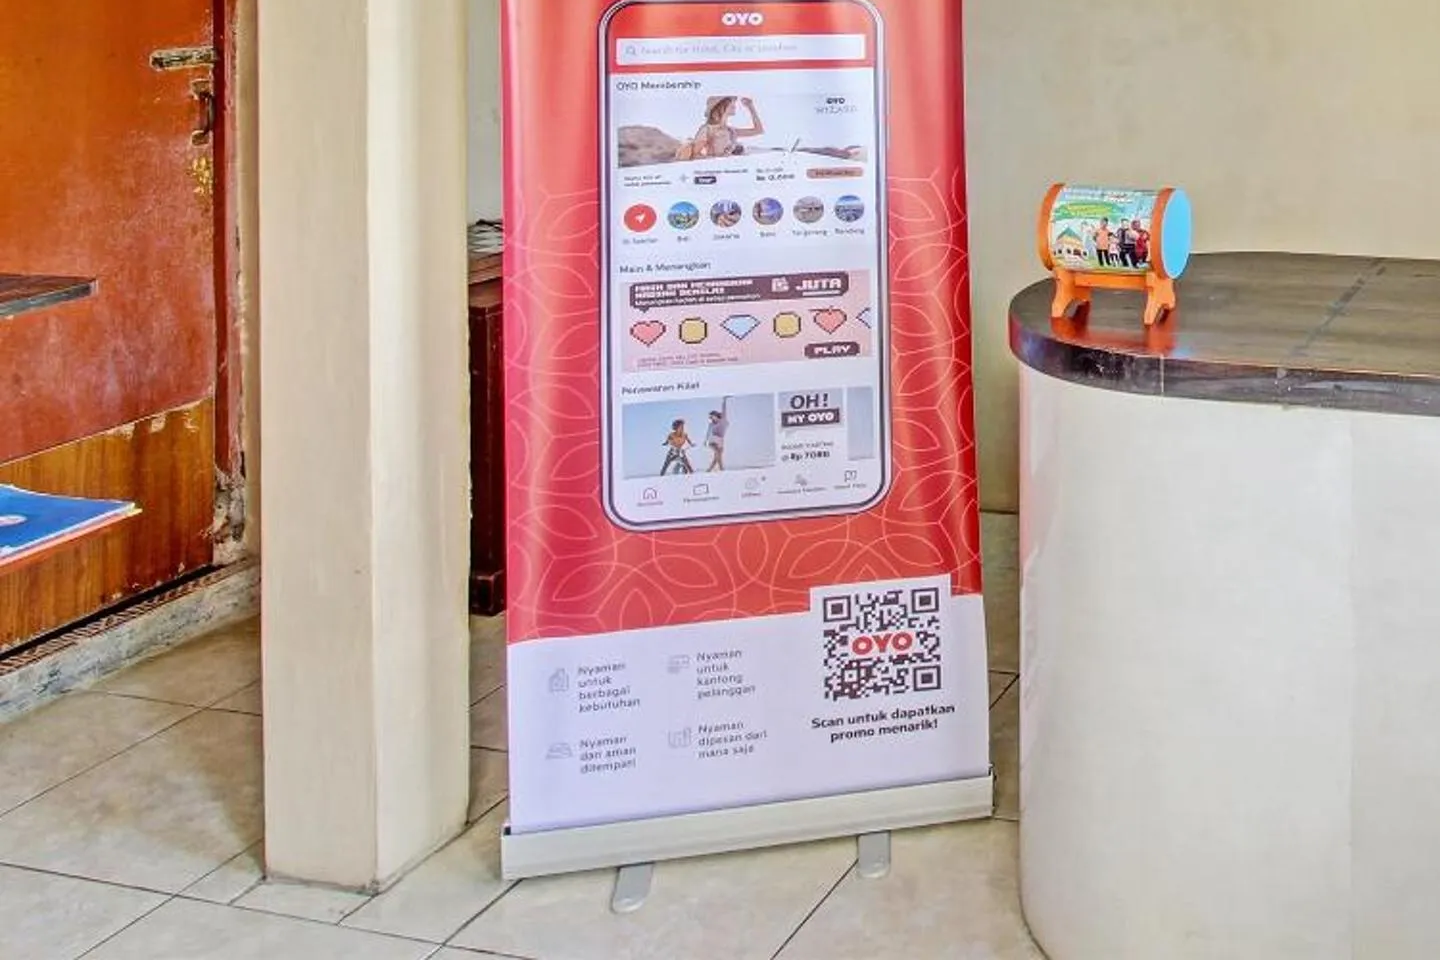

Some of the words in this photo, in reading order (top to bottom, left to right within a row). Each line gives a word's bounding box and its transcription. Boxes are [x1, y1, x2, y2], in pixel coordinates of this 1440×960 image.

[722, 13, 763, 26] OYO
[616, 82, 638, 91] OYO
[641, 81, 702, 91] Membership
[619, 265, 643, 273] Main
[795, 278, 842, 291] JUTA
[814, 345, 851, 355] PLAY
[790, 393, 829, 409] OH!
[787, 415, 806, 424] MY
[807, 412, 835, 422] OYO
[852, 632, 913, 655] OYO
[696, 650, 742, 662] Nyaman
[577, 663, 626, 676] Nyaman
[696, 662, 729, 674] untuk
[577, 676, 612, 688] untuk
[696, 675, 744, 686] kantong
[579, 685, 631, 700] berbagai
[697, 685, 756, 700] pelanggan
[579, 698, 641, 713] kebutuhan
[811, 717, 844, 729] Scan
[847, 711, 888, 725] untuk
[891, 704, 956, 720] dapatkan
[698, 721, 744, 734] Nyaman
[830, 727, 875, 743] promo
[879, 718, 938, 735] menarik!
[580, 737, 627, 748] Nyaman
